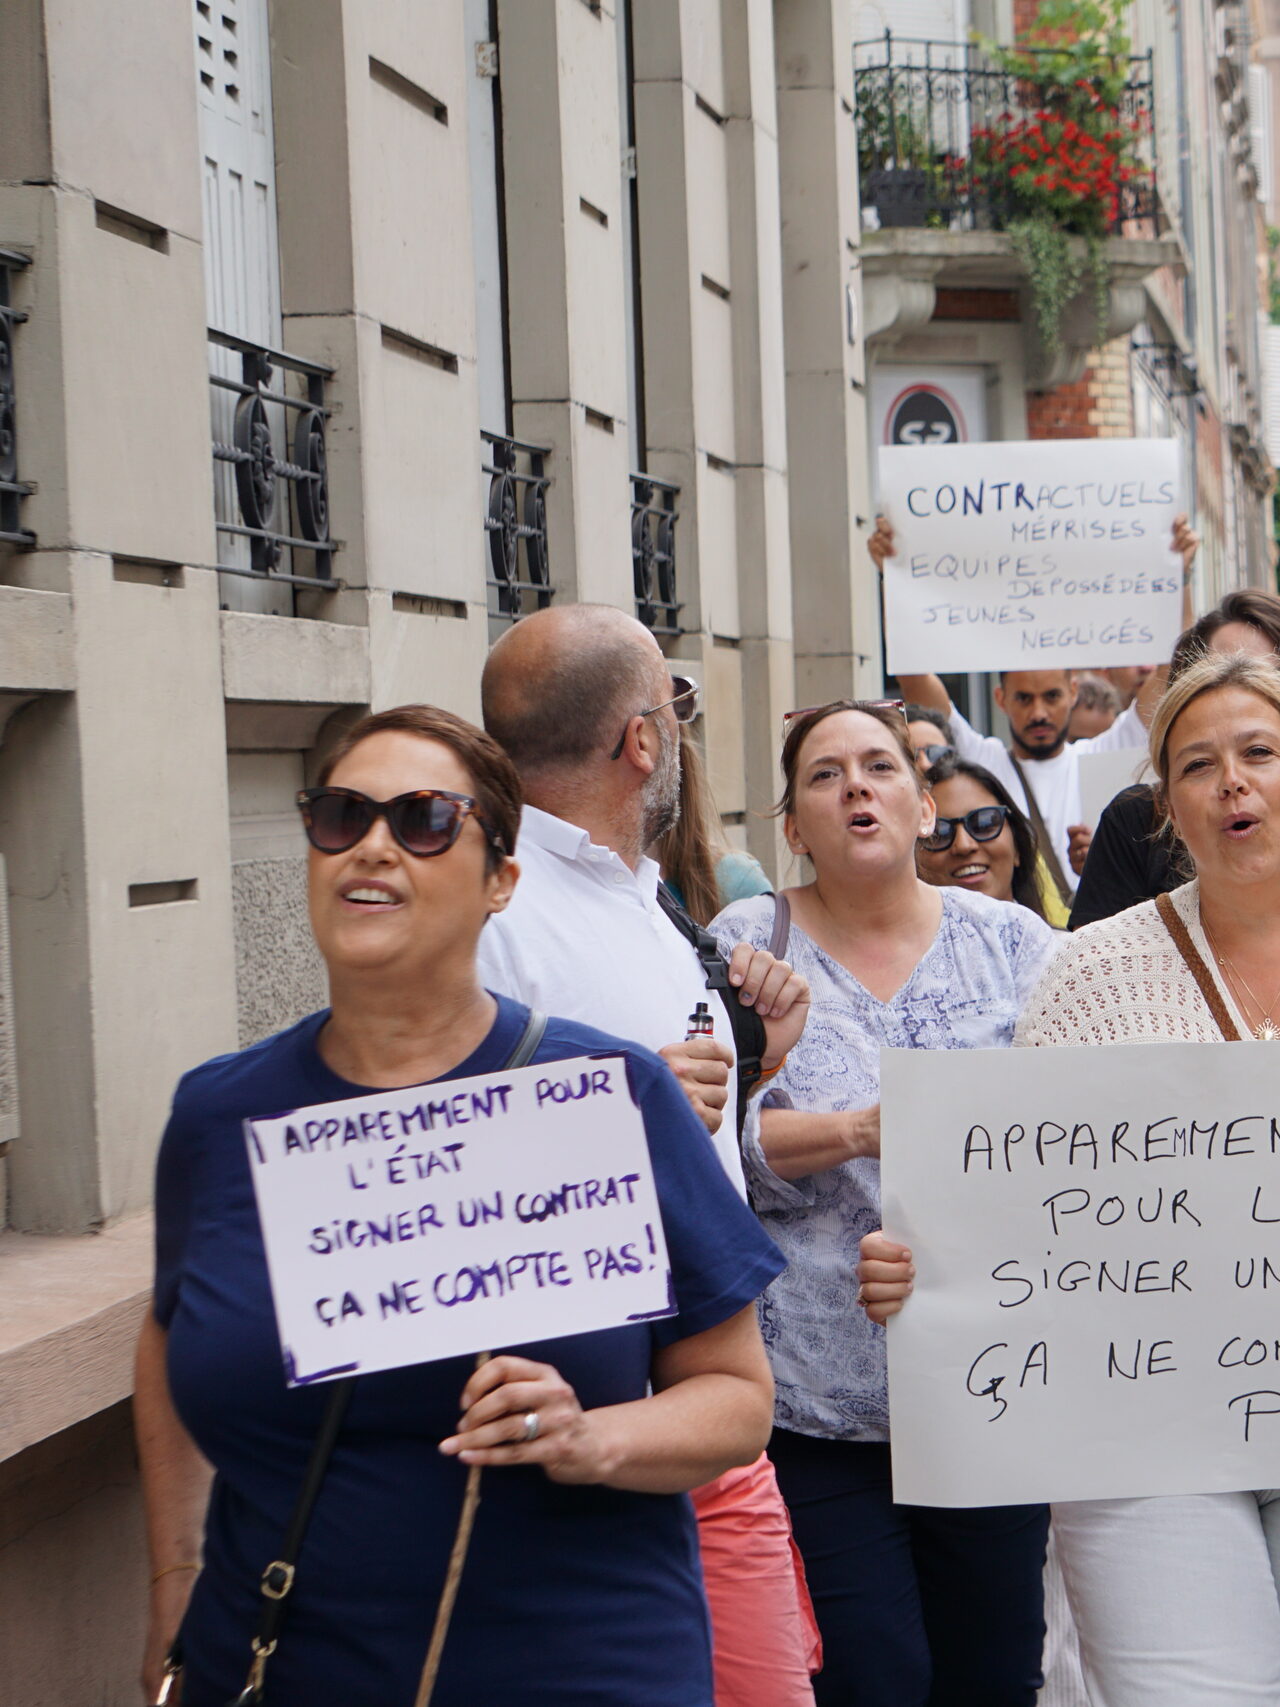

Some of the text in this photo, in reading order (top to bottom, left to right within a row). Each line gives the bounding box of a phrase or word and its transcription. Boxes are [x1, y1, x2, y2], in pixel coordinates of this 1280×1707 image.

[907, 478, 1174, 518] CONTRACTUELS
[923, 605, 1036, 626] JEUNES
[284, 1070, 614, 1156] APPAREMMENT POUR
[348, 1142, 465, 1190] L'ÉTAT
[458, 1190, 503, 1228] UN
[515, 1173, 640, 1224] CONTRAT
[1042, 1187, 1202, 1236] POUR
[315, 1222, 657, 1328] ÇA NE COMPTE PAS!
[966, 1341, 1048, 1423] ÇA
[1108, 1338, 1178, 1380] NE
